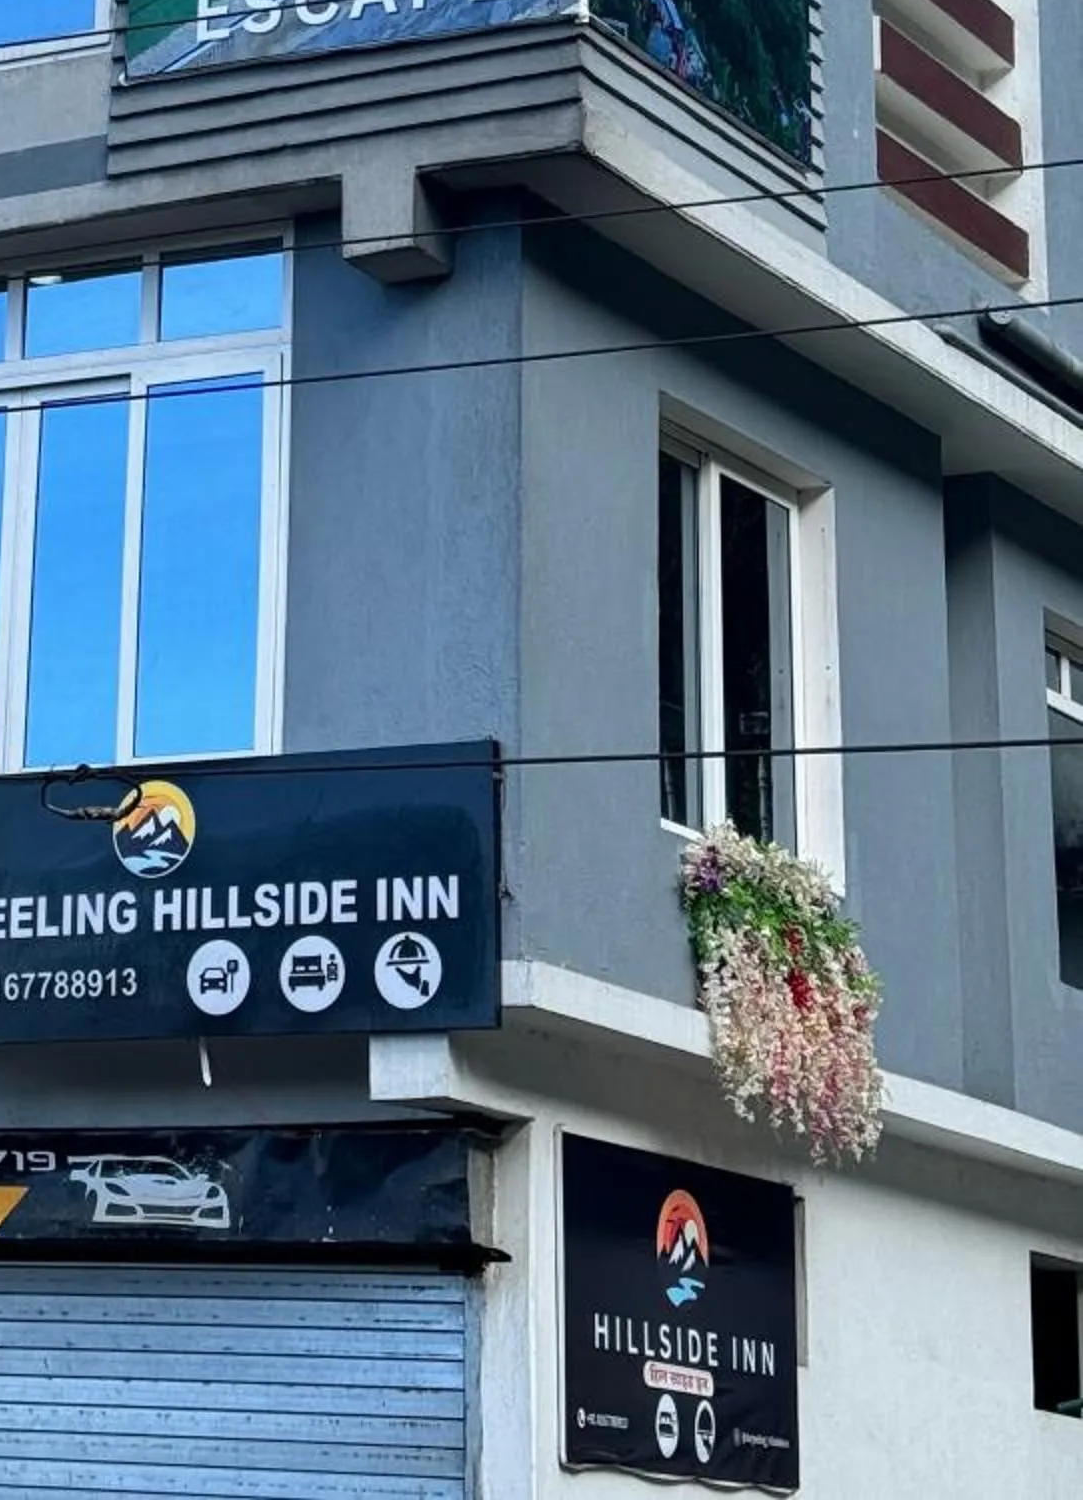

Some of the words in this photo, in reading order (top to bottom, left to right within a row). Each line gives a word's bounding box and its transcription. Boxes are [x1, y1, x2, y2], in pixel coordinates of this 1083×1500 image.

[153, 879, 358, 932] HILLSIDE
[375, 874, 460, 921] INN
[594, 1313, 720, 1367] HILLSIDE
[731, 1336, 776, 1377] INN
